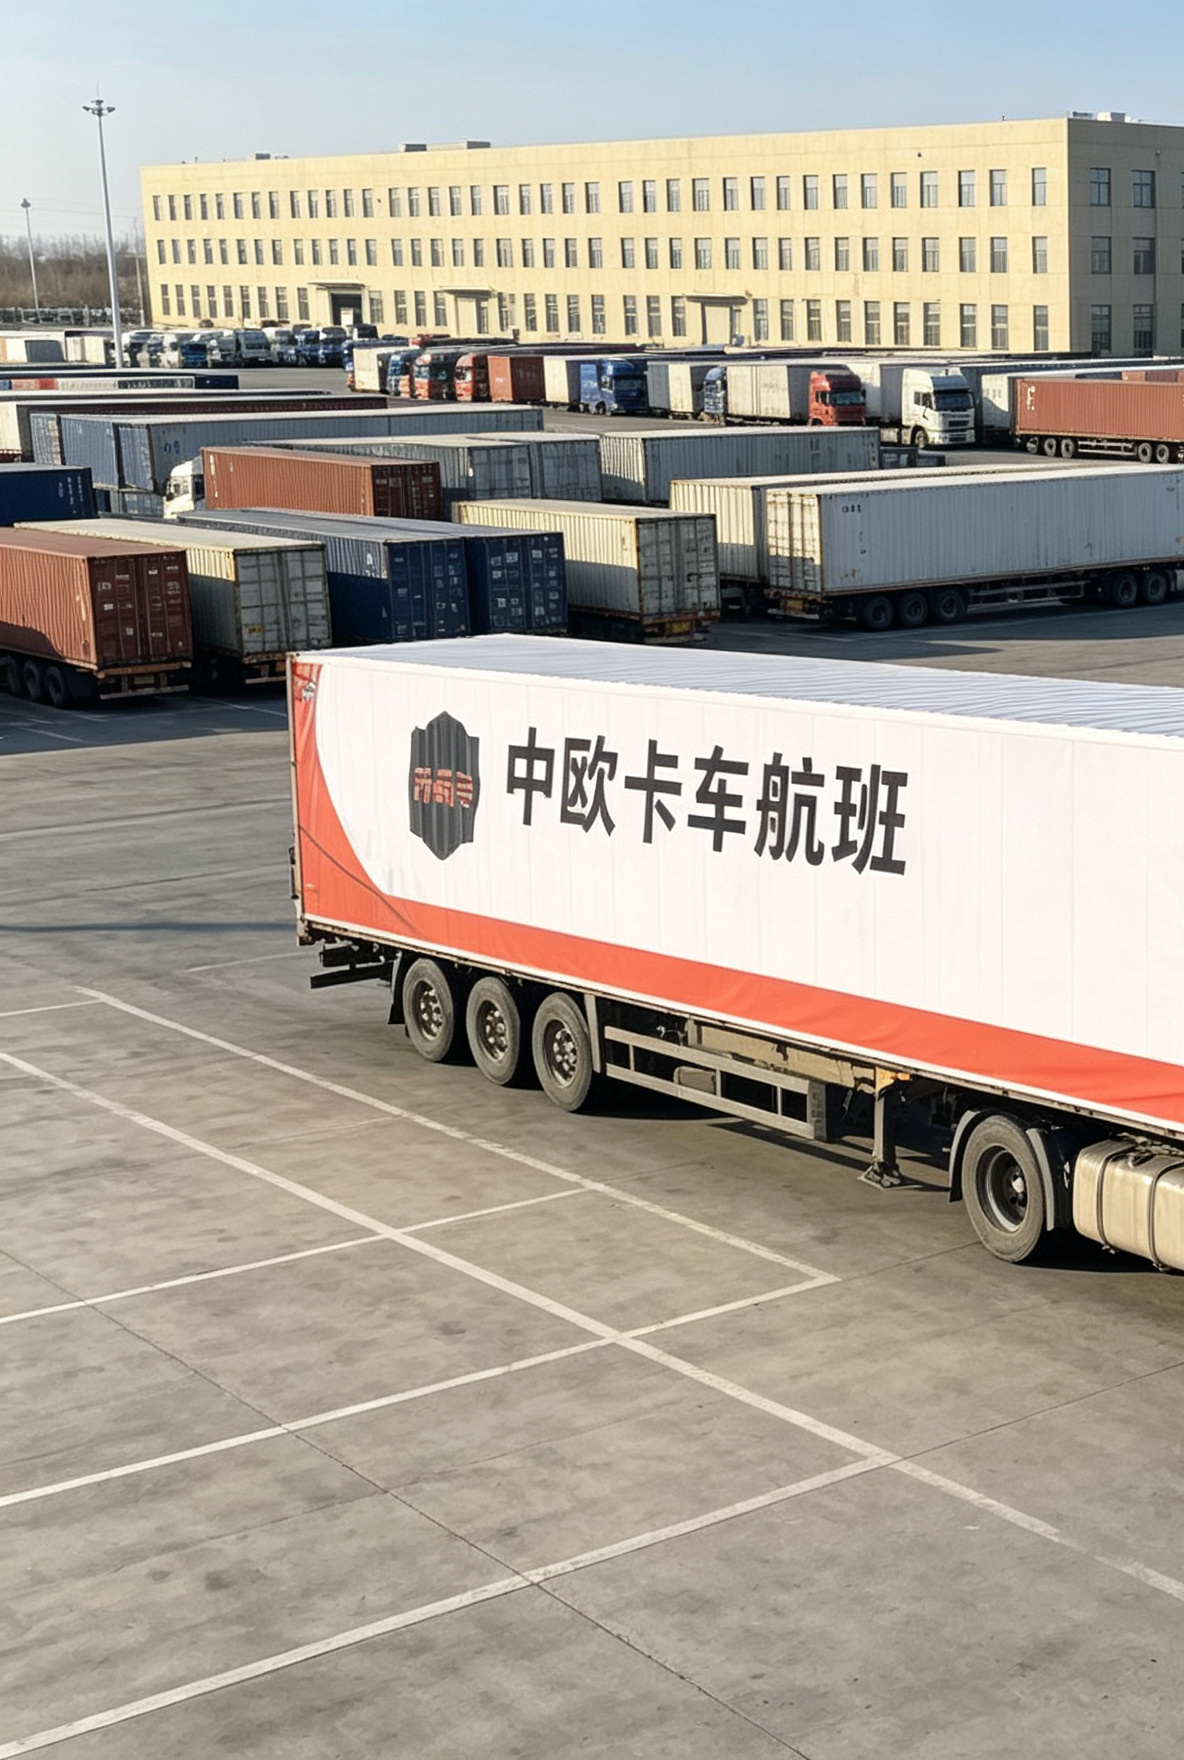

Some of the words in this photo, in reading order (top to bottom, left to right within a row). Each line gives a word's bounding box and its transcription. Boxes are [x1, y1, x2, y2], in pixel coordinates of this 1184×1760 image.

[506, 726, 908, 876] 中欧卡车航班
